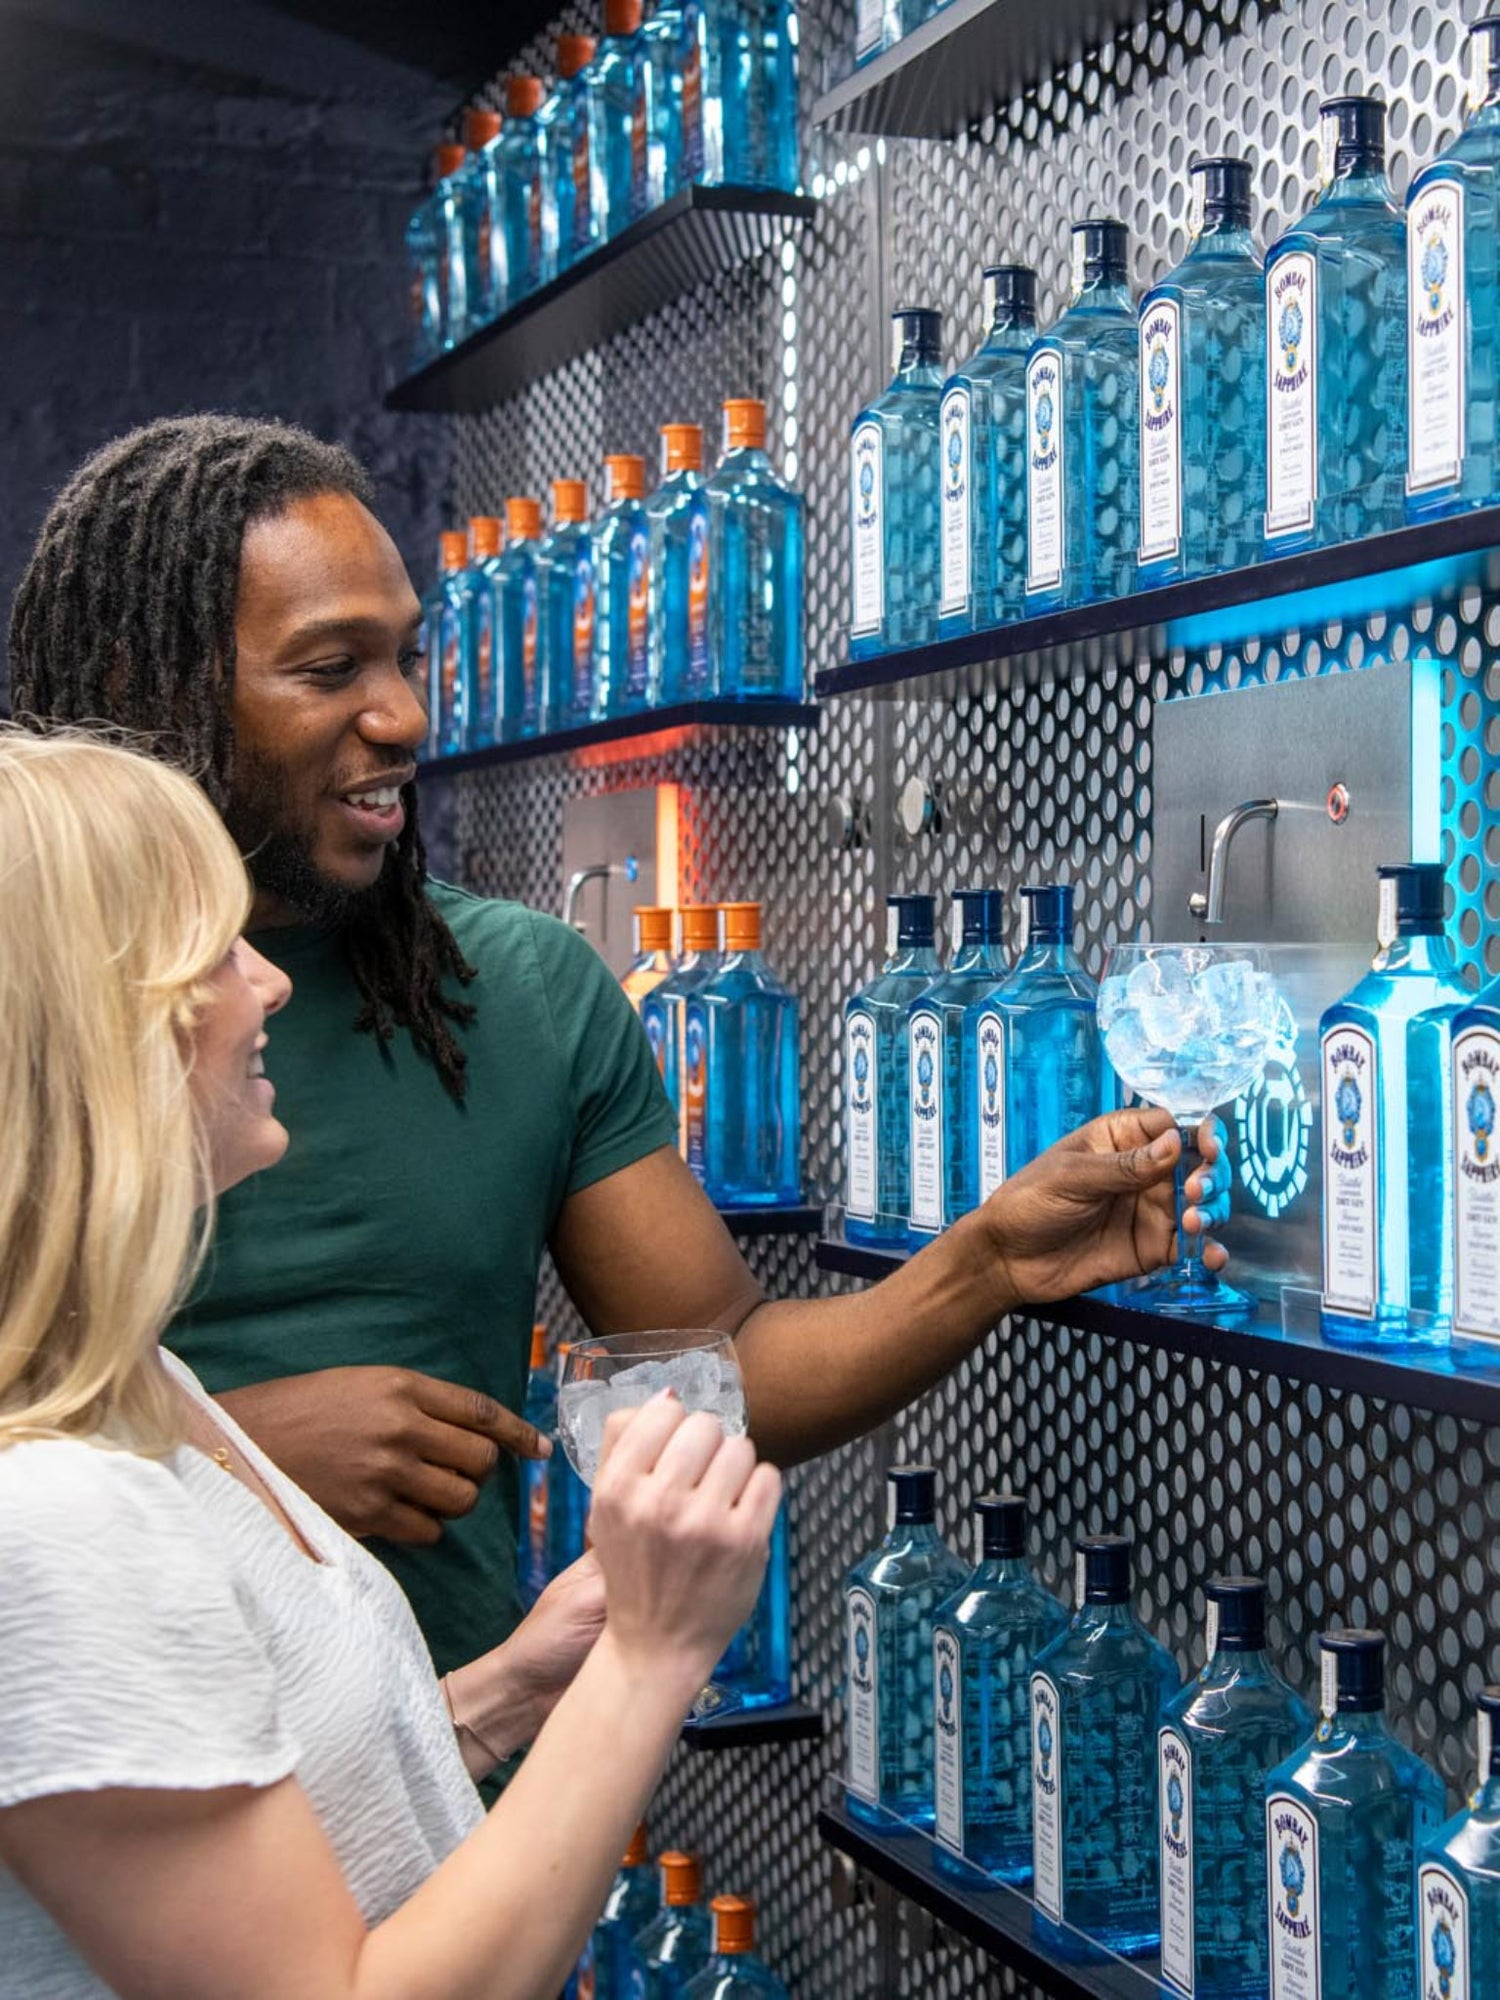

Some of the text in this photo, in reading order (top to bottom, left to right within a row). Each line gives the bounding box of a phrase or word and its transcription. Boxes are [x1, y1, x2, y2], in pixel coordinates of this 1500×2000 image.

[1417, 206, 1451, 243] BOMBAY
[1274, 271, 1306, 304] BOMBAY
[1145, 317, 1172, 347] BOMBAY
[1416, 302, 1454, 337] SAPPHIRE
[1273, 360, 1308, 393] SAPPHIRE
[1145, 400, 1173, 432] SAPPHIRE
[1330, 1044, 1365, 1073] BOMBAY
[1462, 1050, 1500, 1079] BOMBAY
[1330, 1139, 1368, 1169] SAPPHIRE
[1163, 1743, 1186, 1778] BOMBAY
[1273, 1813, 1309, 1849] BOMBAY
[1274, 1901, 1312, 1939] SAPPHIRE
[1427, 1886, 1460, 1924] BOMBAY
